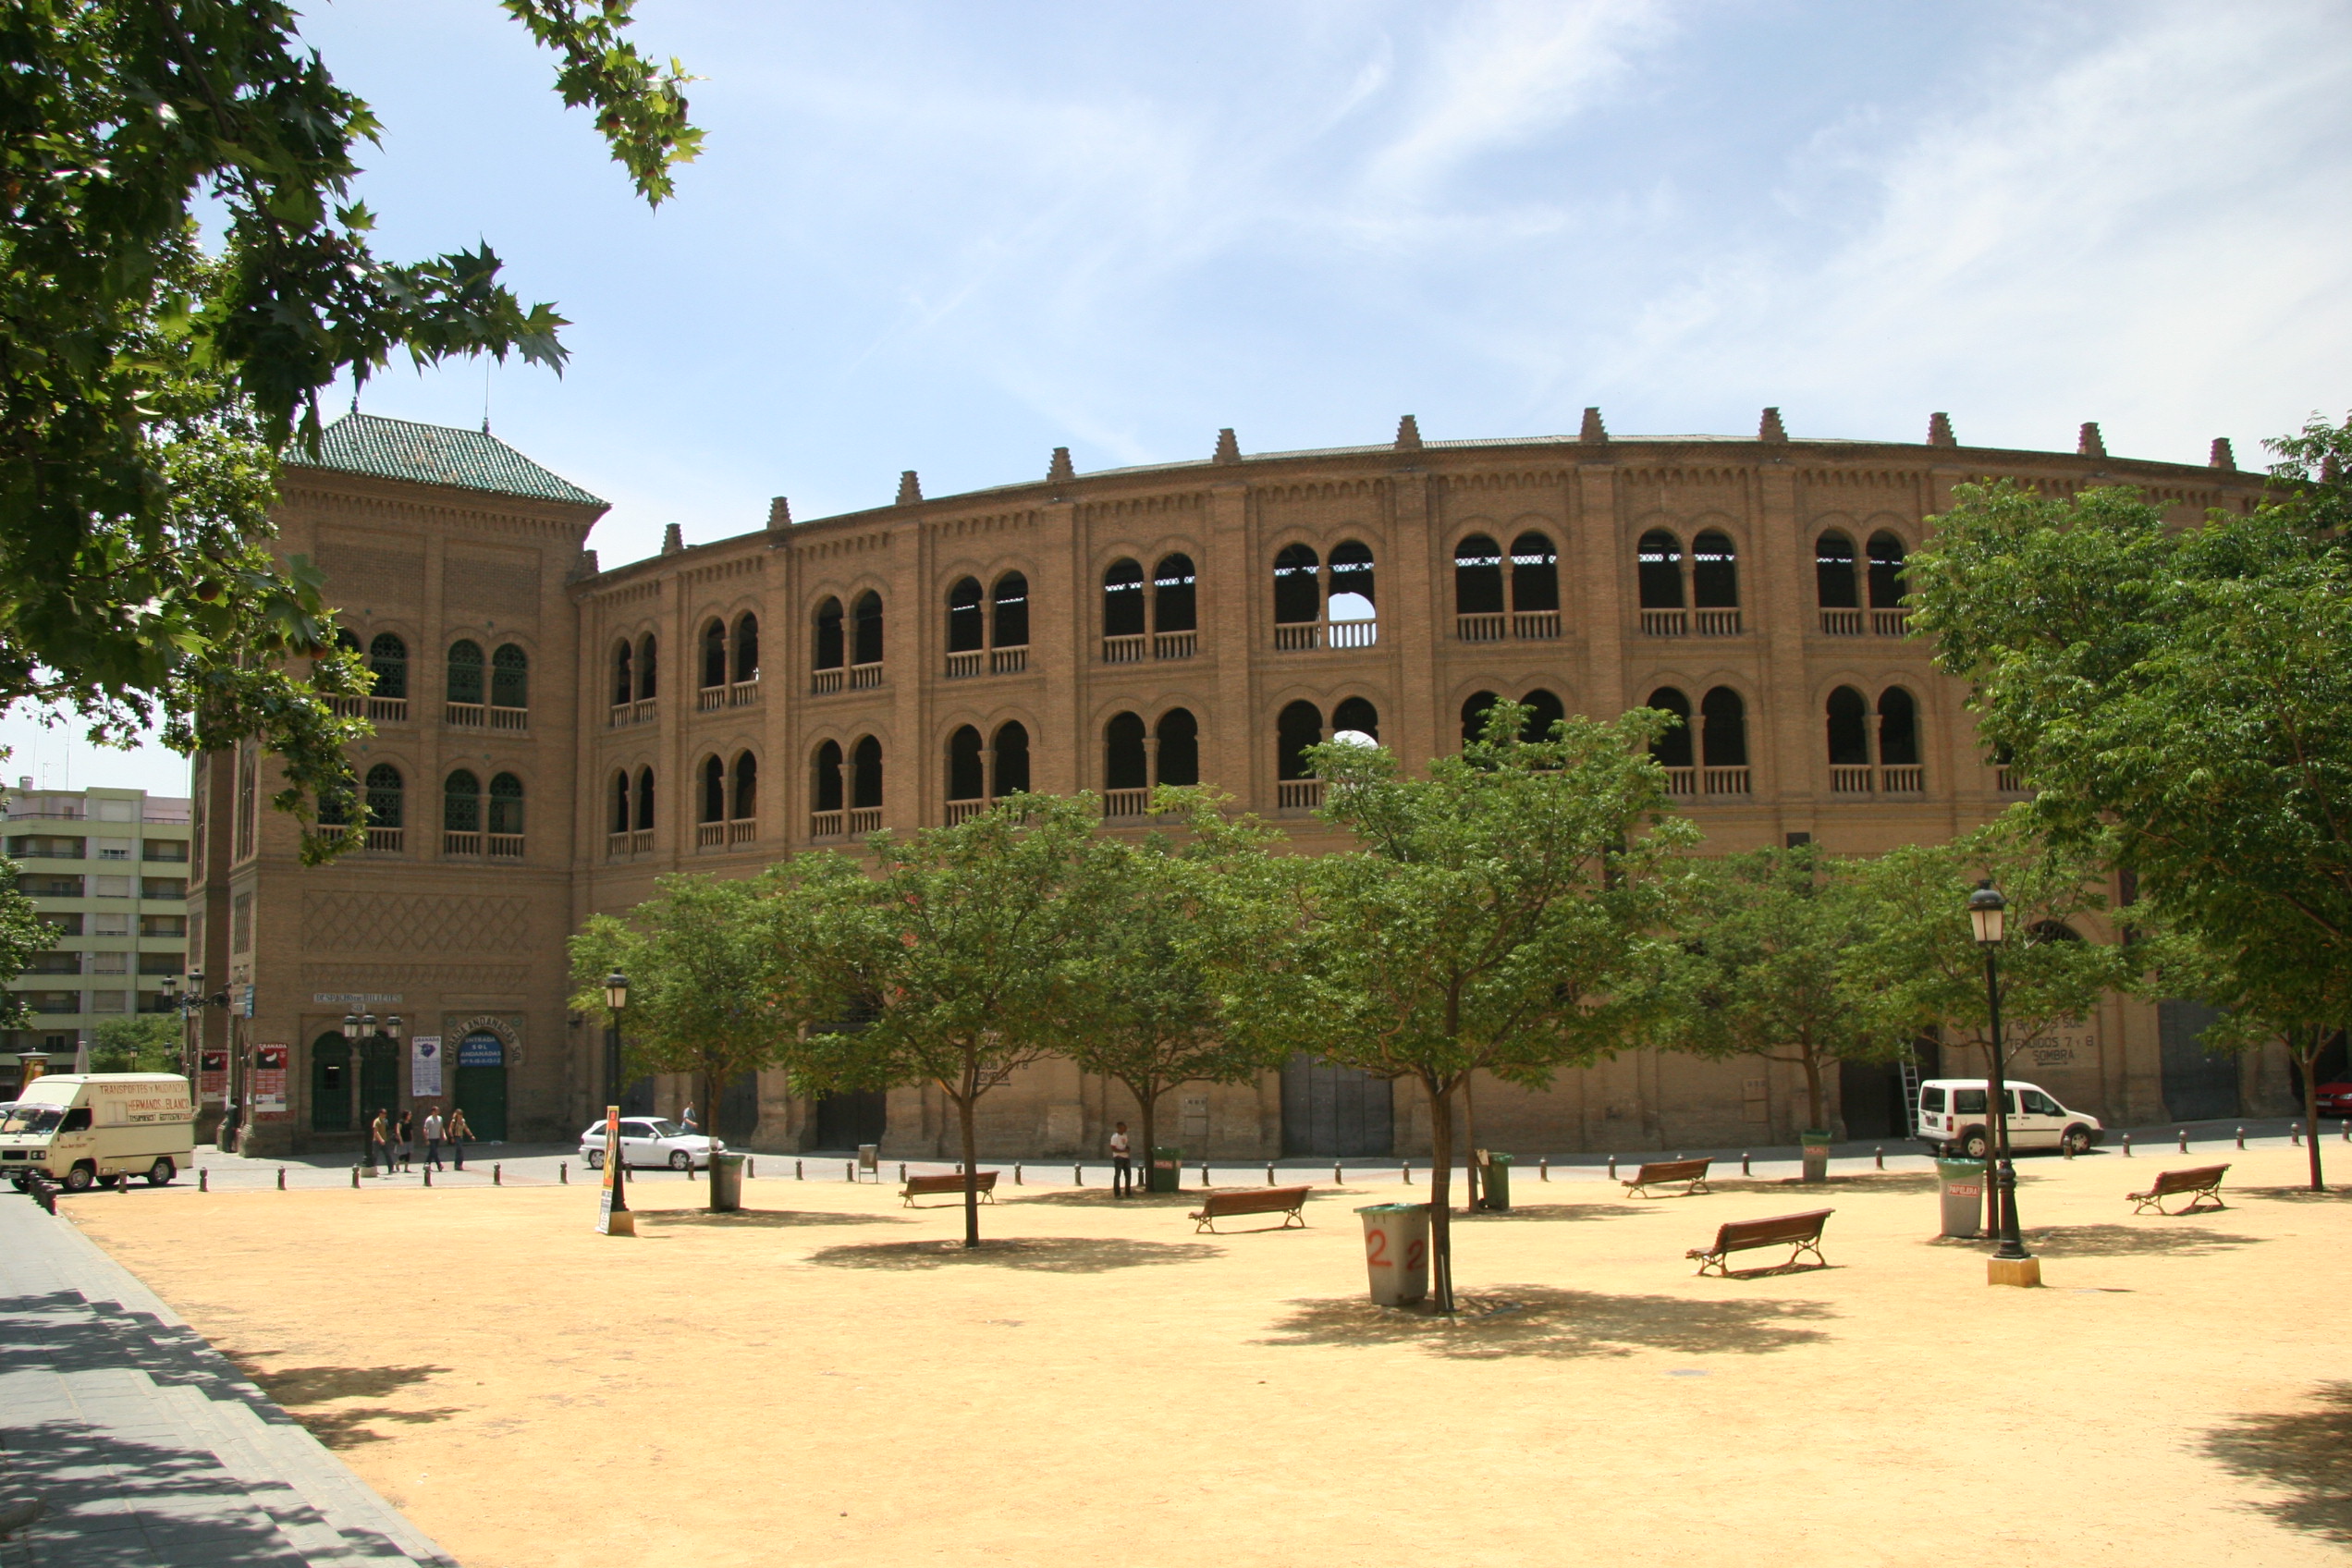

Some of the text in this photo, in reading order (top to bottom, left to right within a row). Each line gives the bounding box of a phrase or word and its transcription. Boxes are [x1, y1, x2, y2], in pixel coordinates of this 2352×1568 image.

[316, 993, 352, 1002] DESPACHO
[445, 1017, 521, 1065] ENTRADA ANDANADAS SOL
[2065, 1036, 2071, 1047] 7
[2086, 1035, 2094, 1046] 8
[2032, 1049, 2075, 1061] SOMBRA
[100, 1084, 148, 1095] TRANSPORTES
[129, 1097, 190, 1110] HERMANOS BLANCO
[1367, 1229, 1427, 1271] 2 2
